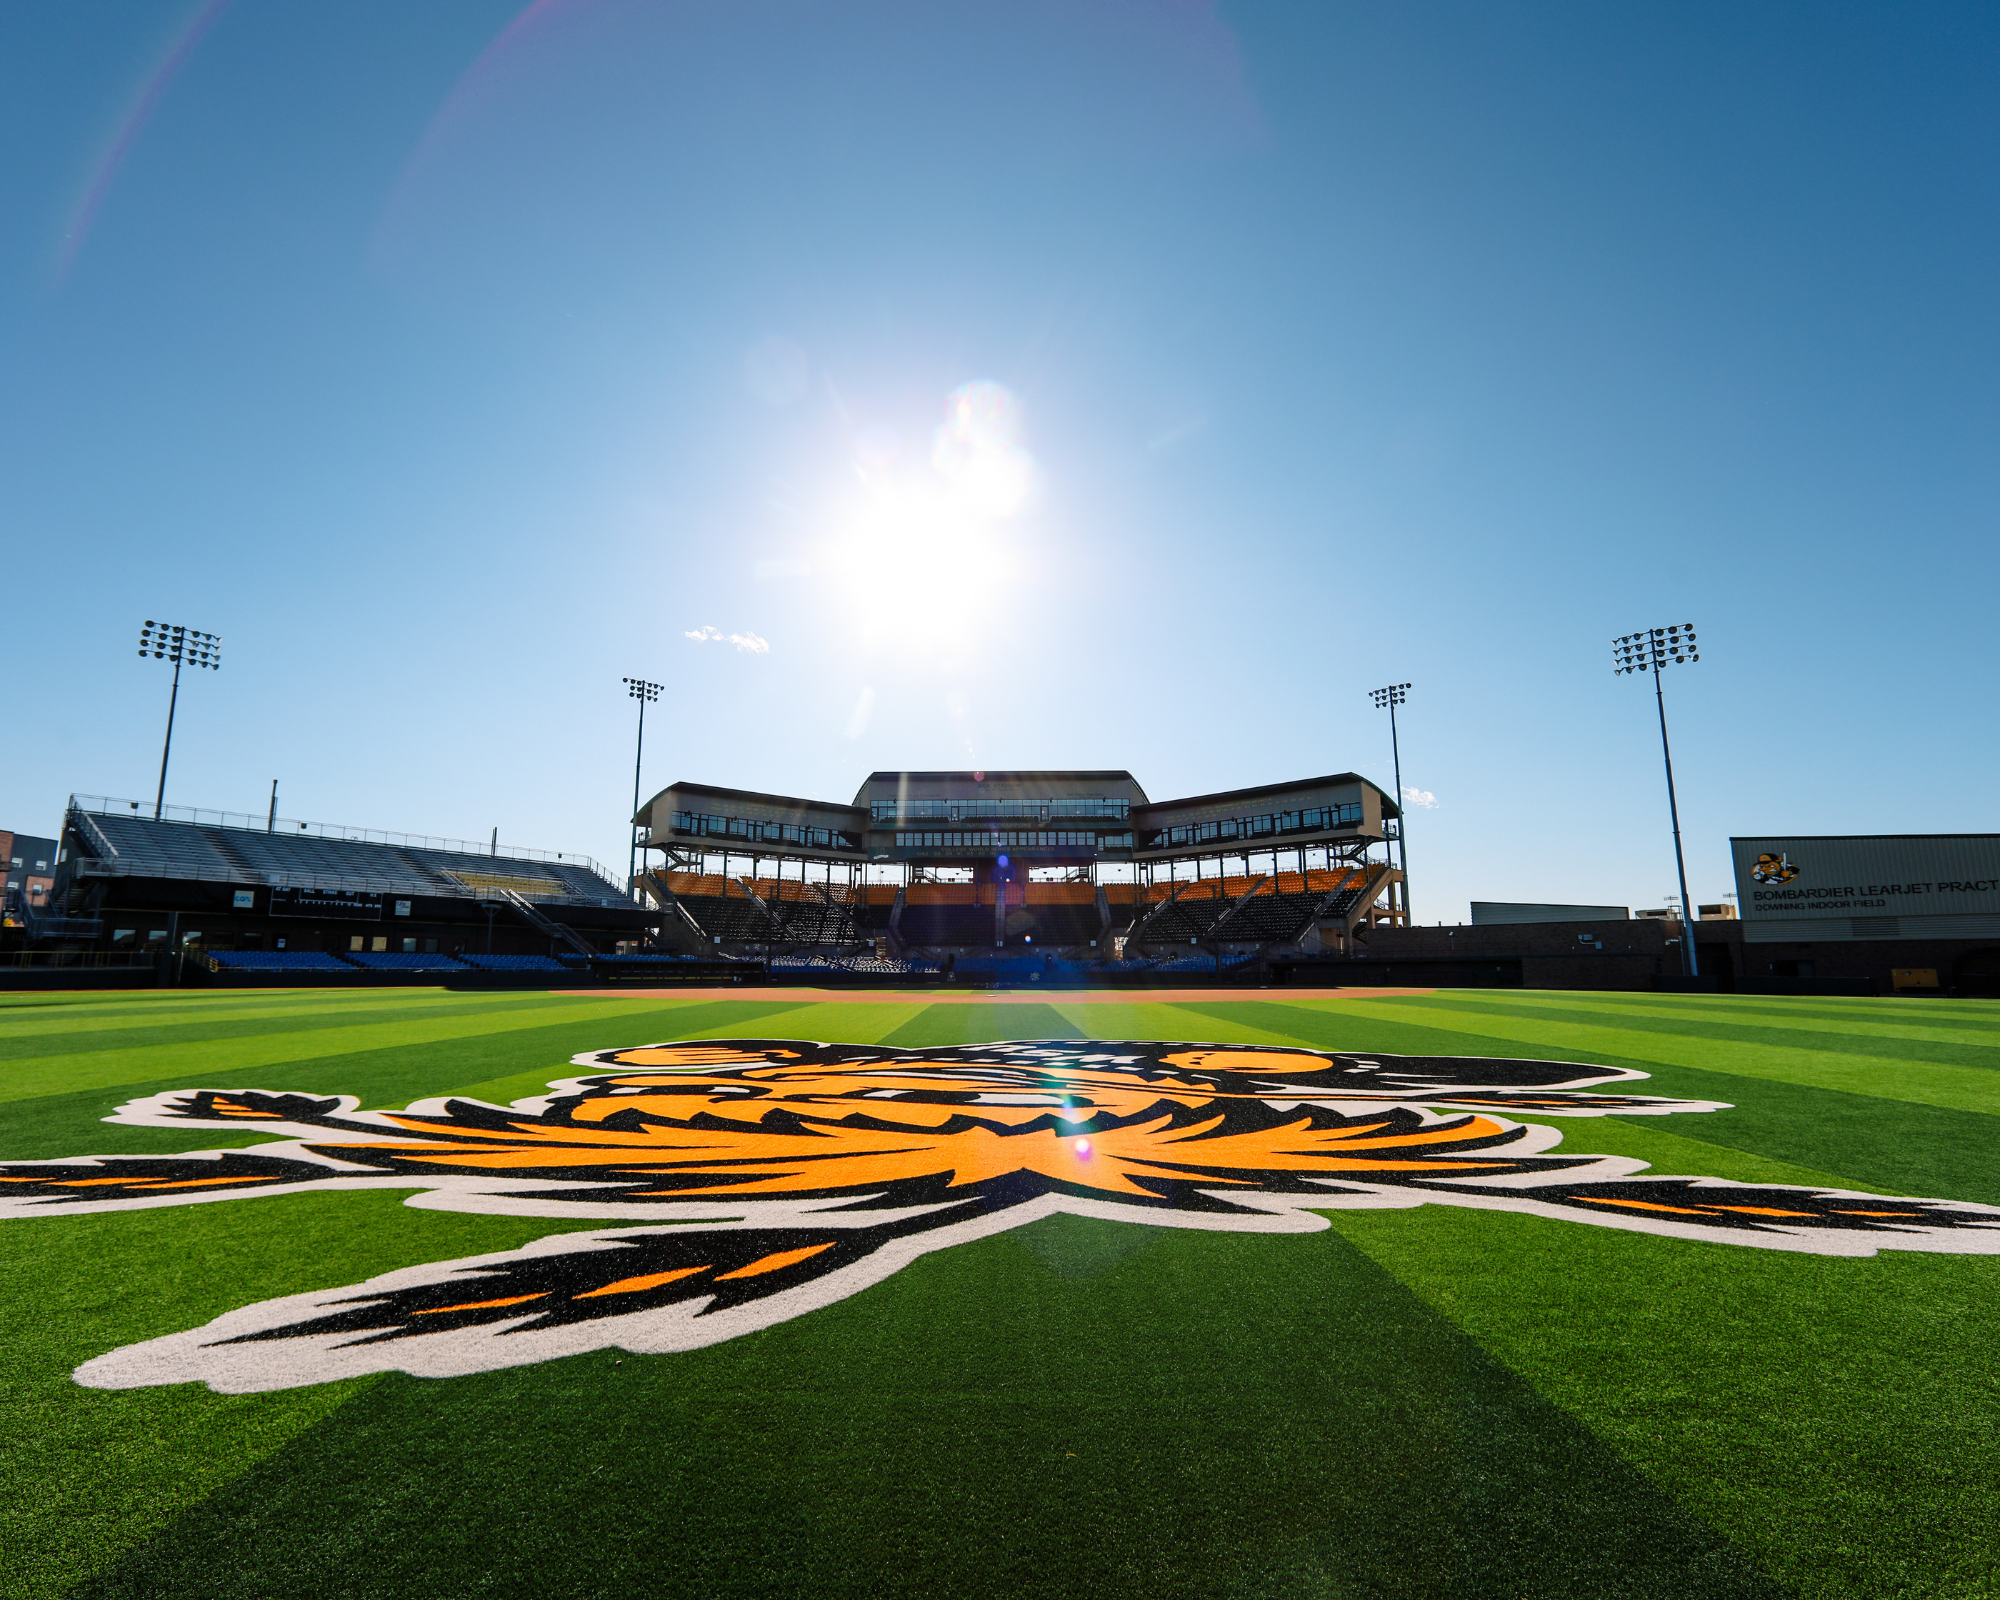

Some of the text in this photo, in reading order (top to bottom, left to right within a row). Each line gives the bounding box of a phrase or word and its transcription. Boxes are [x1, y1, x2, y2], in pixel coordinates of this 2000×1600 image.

[1754, 880, 1999, 901] BOMBARDIER LEARJET PRACT
[1755, 899, 1886, 911] DOWNING INDOOR FIELD
